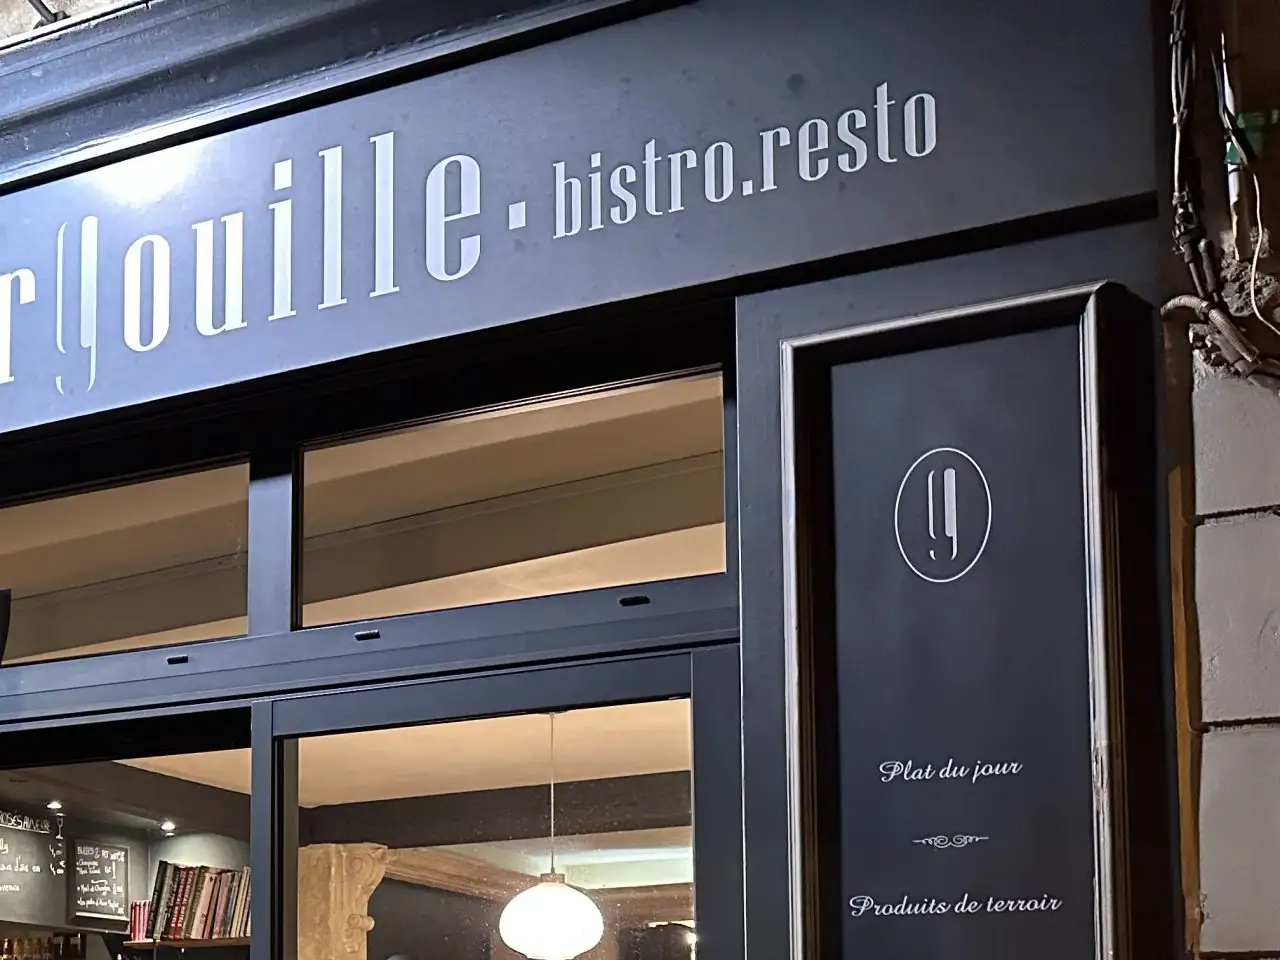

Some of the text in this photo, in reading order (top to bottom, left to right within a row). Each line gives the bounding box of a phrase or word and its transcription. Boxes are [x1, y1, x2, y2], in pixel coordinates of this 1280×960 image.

[553, 82, 937, 239] bistro.resto
[879, 759, 1023, 783] Plat du jour
[849, 893, 1062, 917] Produits de terroir
